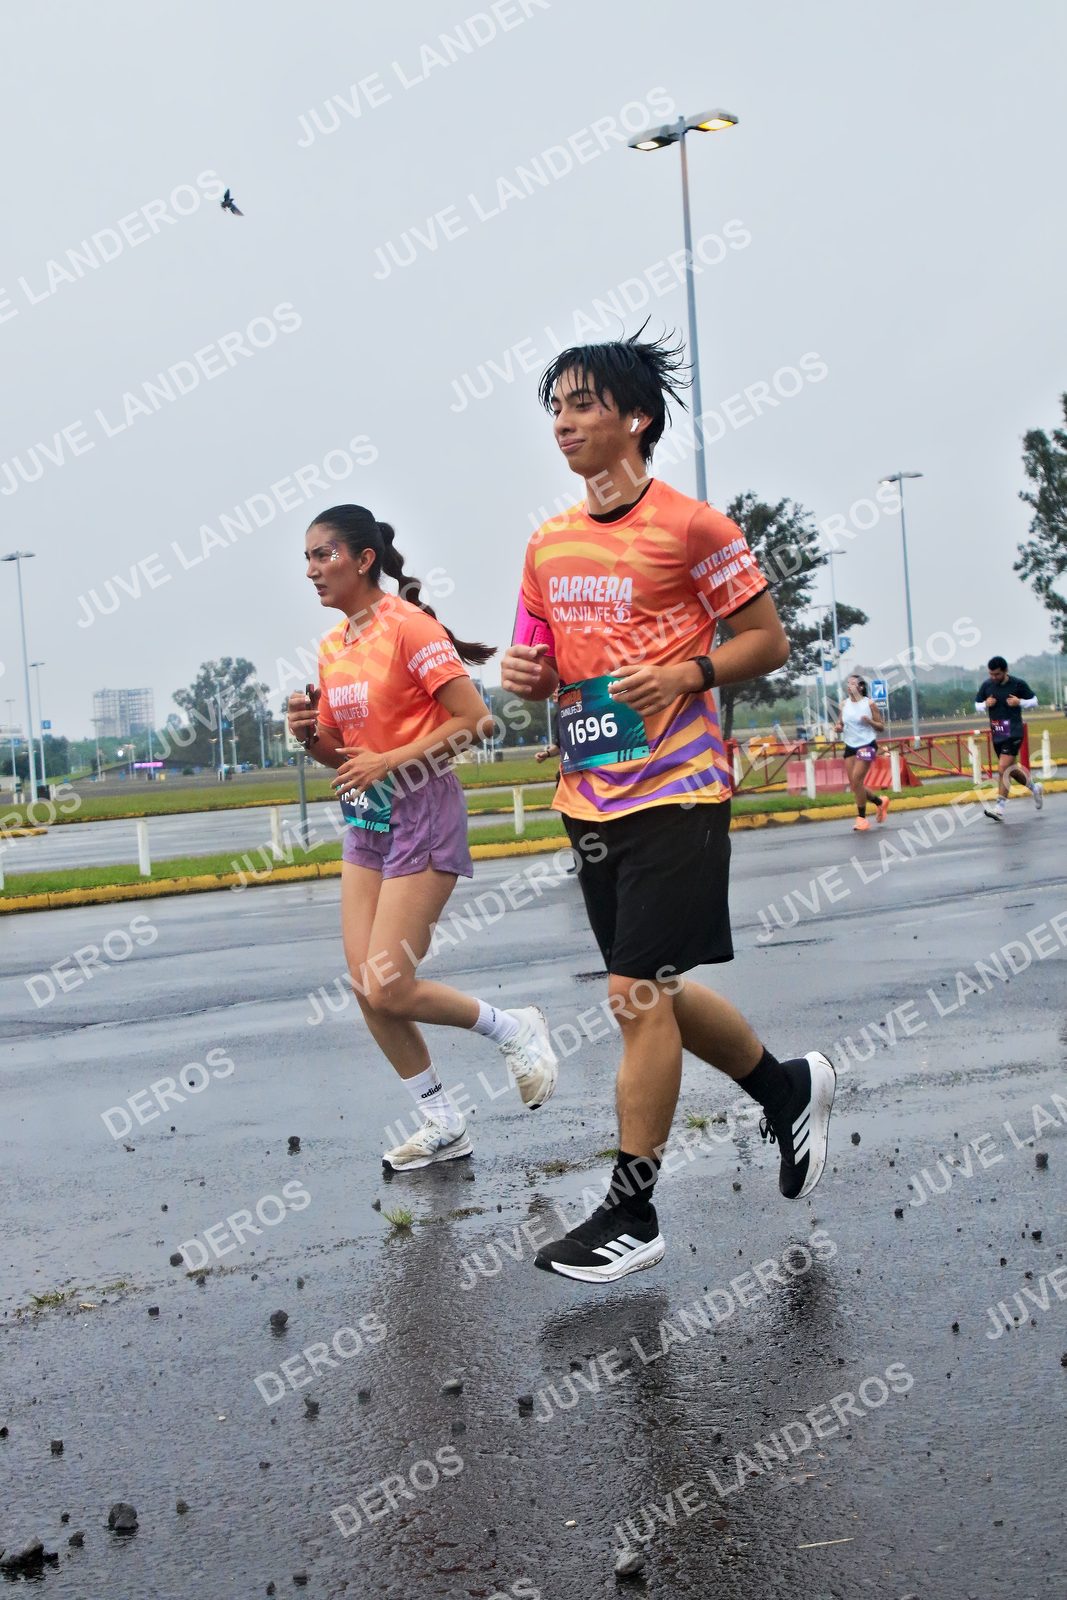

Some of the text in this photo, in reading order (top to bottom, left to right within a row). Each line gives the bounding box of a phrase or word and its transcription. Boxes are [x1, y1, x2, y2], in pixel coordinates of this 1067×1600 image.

[549, 576, 633, 603] CARRERA
[553, 606, 611, 622] OMNILIFE
[333, 707, 361, 721] MNILIFE
[567, 713, 618, 746] 1696
[341, 788, 369, 810] 94
[421, 1082, 442, 1099] adida
